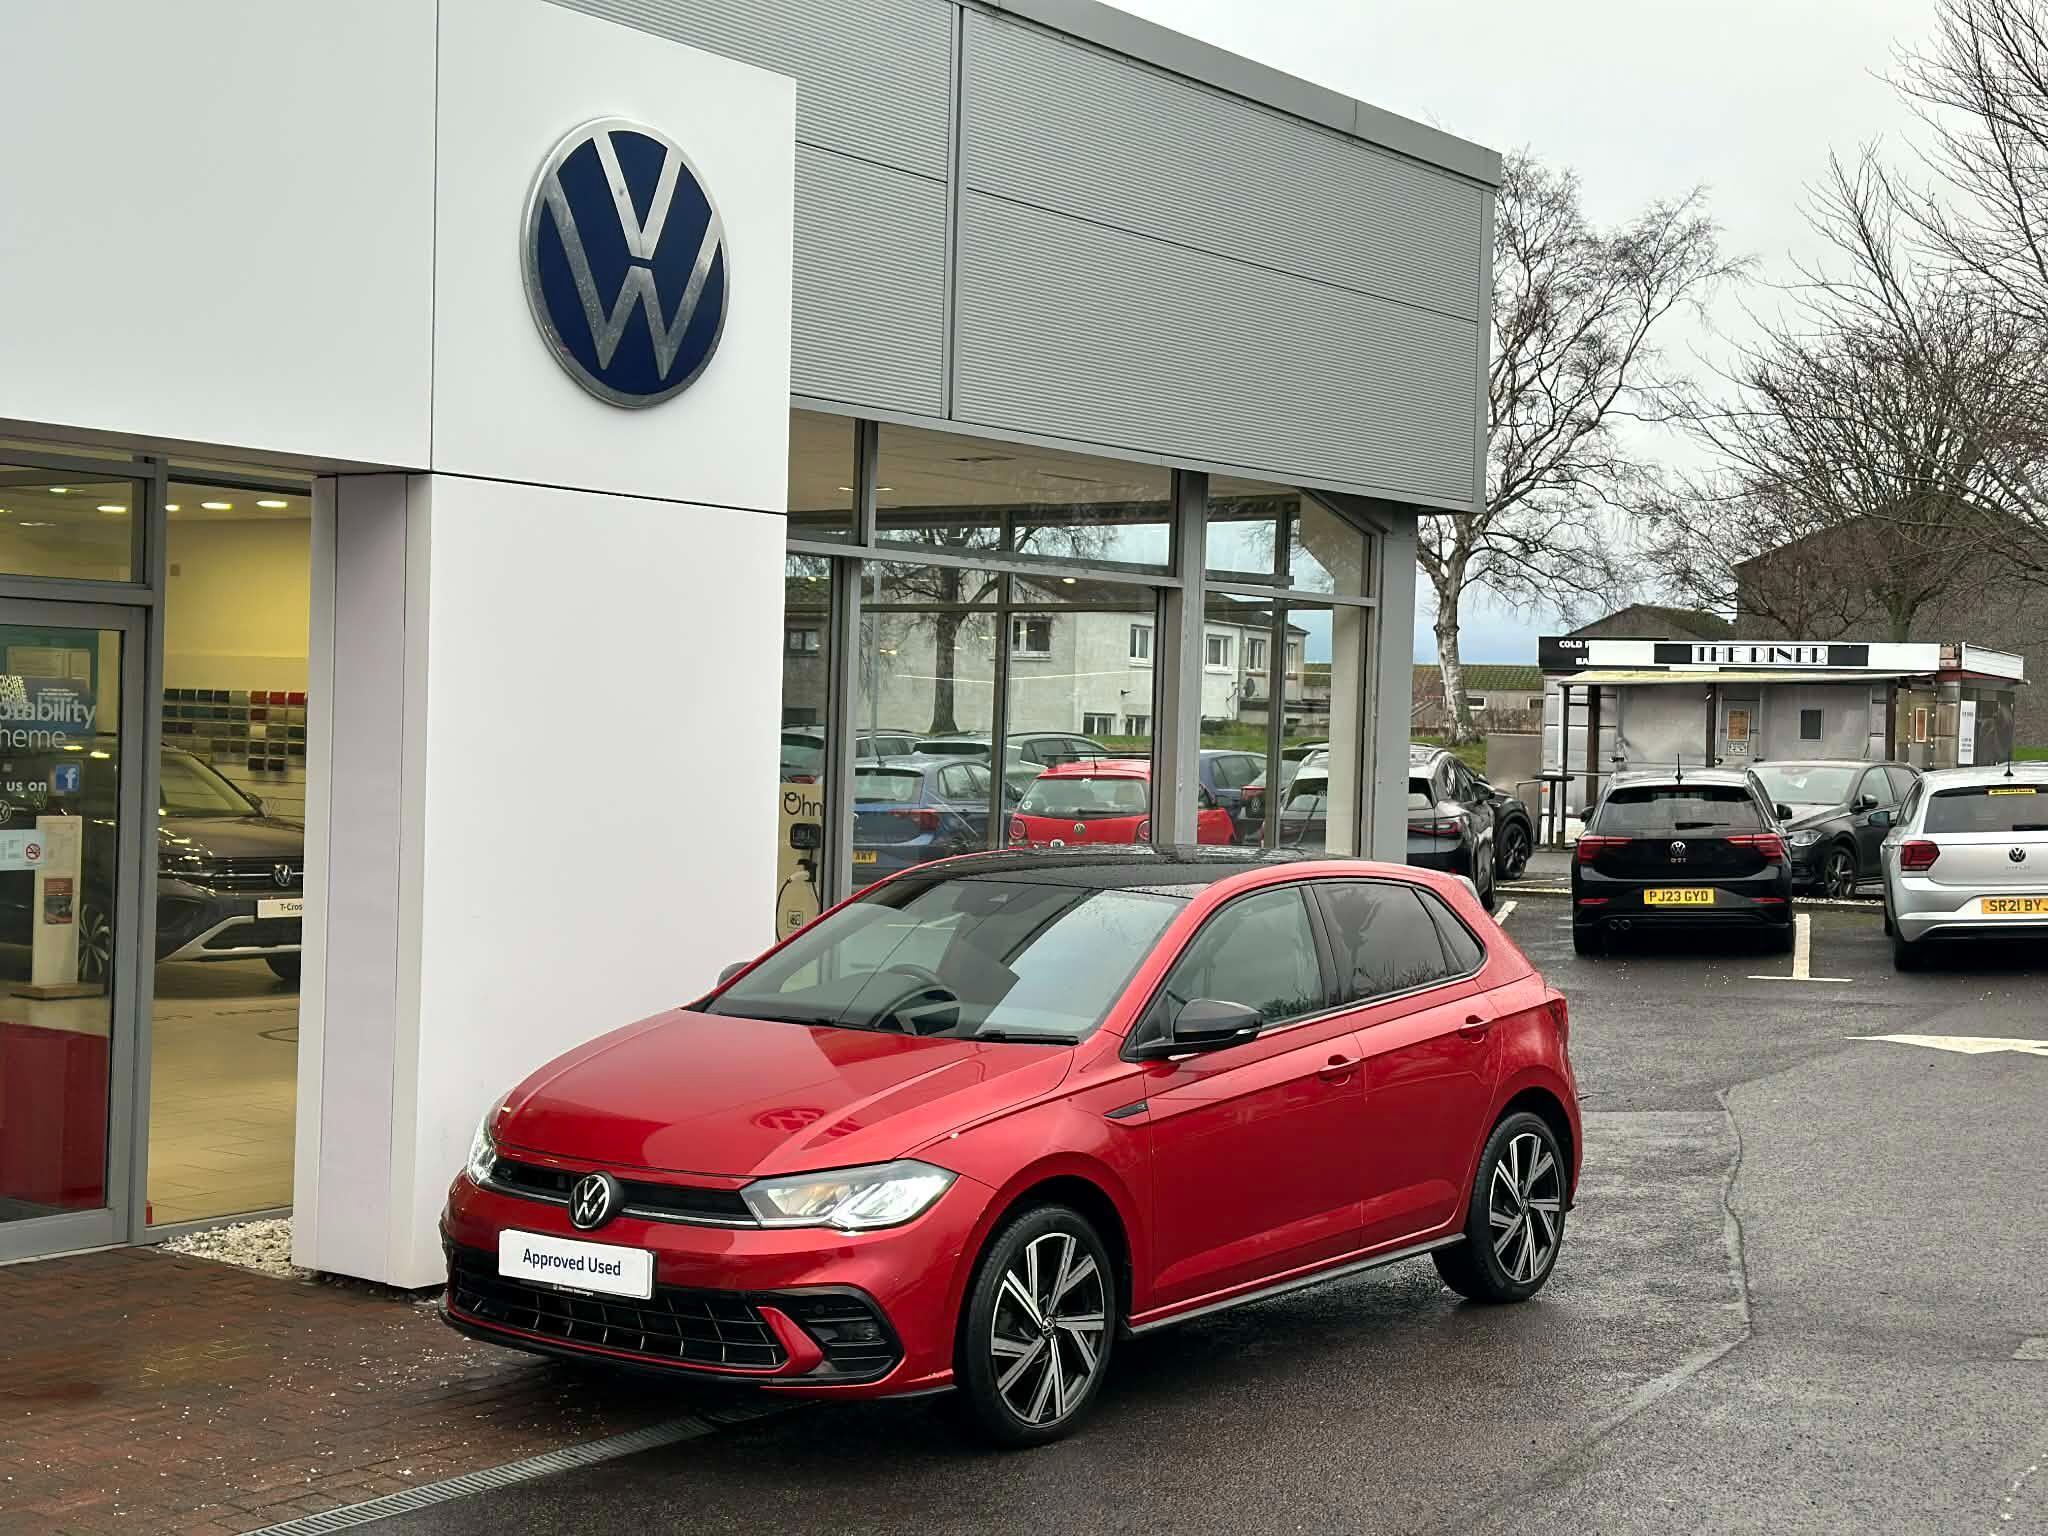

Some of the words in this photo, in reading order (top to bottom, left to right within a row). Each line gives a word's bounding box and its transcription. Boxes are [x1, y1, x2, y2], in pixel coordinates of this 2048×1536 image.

[1558, 640, 1583, 649] COLD
[1693, 645, 1747, 664] THE
[1749, 646, 1827, 665] DINER
[6, 781, 24, 792] us
[28, 781, 48, 792] on
[1649, 890, 1682, 902] PJ23
[1684, 890, 1708, 902] GYD
[1989, 899, 2021, 912] SR21
[522, 1248, 585, 1272] Approved
[588, 1256, 622, 1277] Used
